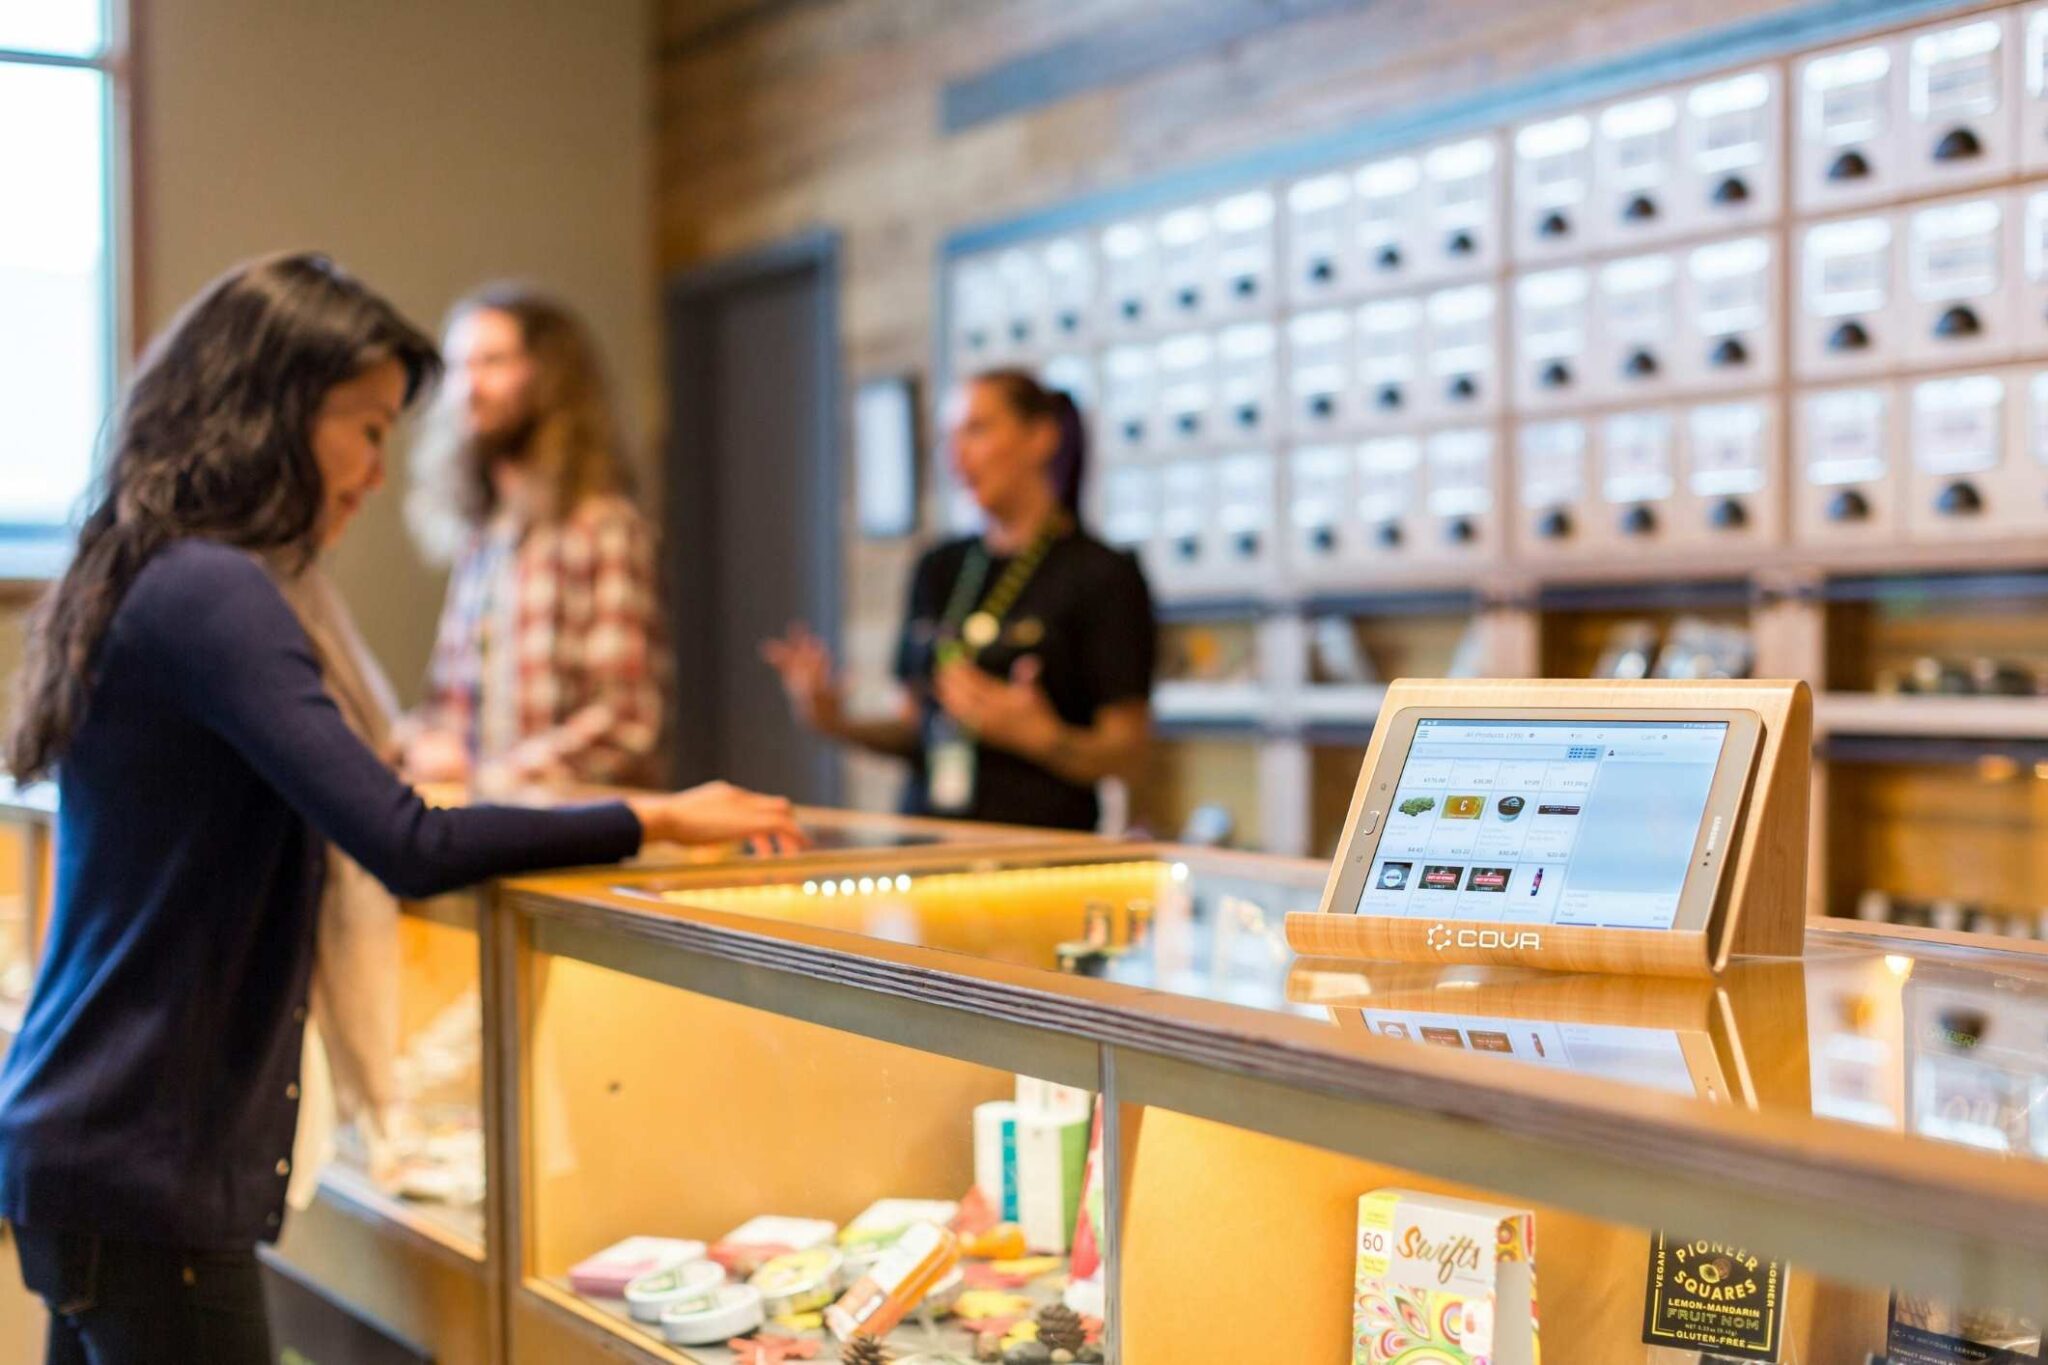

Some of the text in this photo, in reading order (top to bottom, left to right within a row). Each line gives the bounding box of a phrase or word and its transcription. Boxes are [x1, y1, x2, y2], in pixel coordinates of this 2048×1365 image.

[1457, 929, 1540, 951] COVA
[1362, 1231, 1384, 1252] 60
[1395, 1223, 1481, 1285] Swifts
[1675, 1239, 1758, 1271] PIONEER
[1656, 1251, 1666, 1288] VEGAN
[1674, 1270, 1757, 1300] SQUARES
[1767, 1261, 1777, 1307] KOSHER
[1666, 1307, 1761, 1331] FRUIT NOM
[1668, 1297, 1760, 1317] LEMON-MANDARIN
[1676, 1330, 1746, 1348] GLUTEN-FREE
